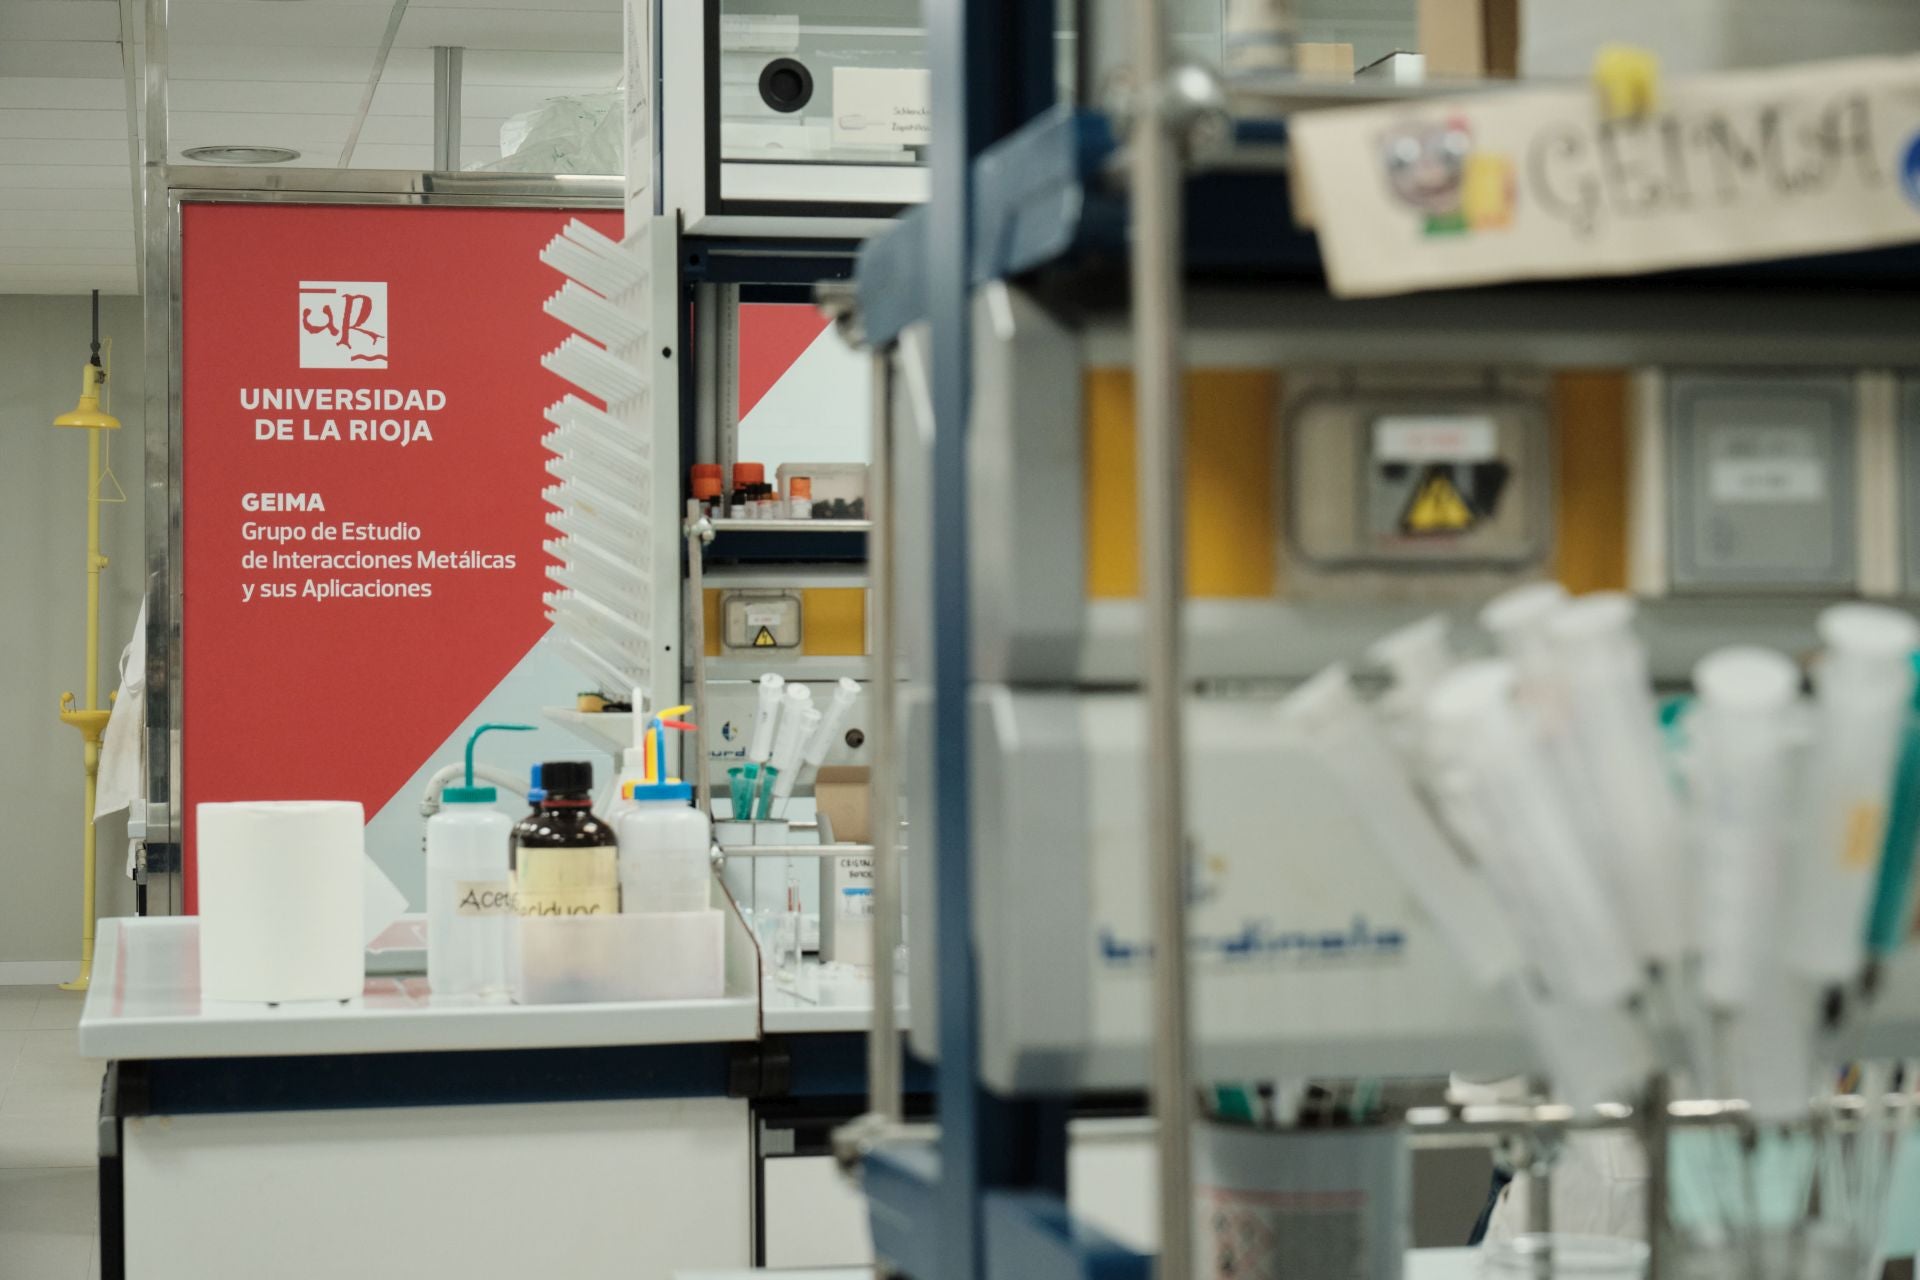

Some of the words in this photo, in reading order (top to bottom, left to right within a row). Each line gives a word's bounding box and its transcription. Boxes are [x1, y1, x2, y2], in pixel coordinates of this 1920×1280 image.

[240, 387, 447, 411] UNIVERSIDAD
[255, 418, 294, 441] DE
[303, 419, 341, 441] LA
[349, 419, 433, 448] RIOJA
[241, 492, 326, 512] GEIMA
[241, 521, 307, 545] Grupo
[310, 521, 338, 541] de
[341, 521, 421, 541] Estudio
[241, 550, 268, 569] de
[272, 550, 413, 569] Interacciones
[417, 550, 517, 569] Metálicas
[241, 583, 256, 603] y
[260, 583, 297, 598] sus
[301, 578, 432, 602] Aplicaciones
